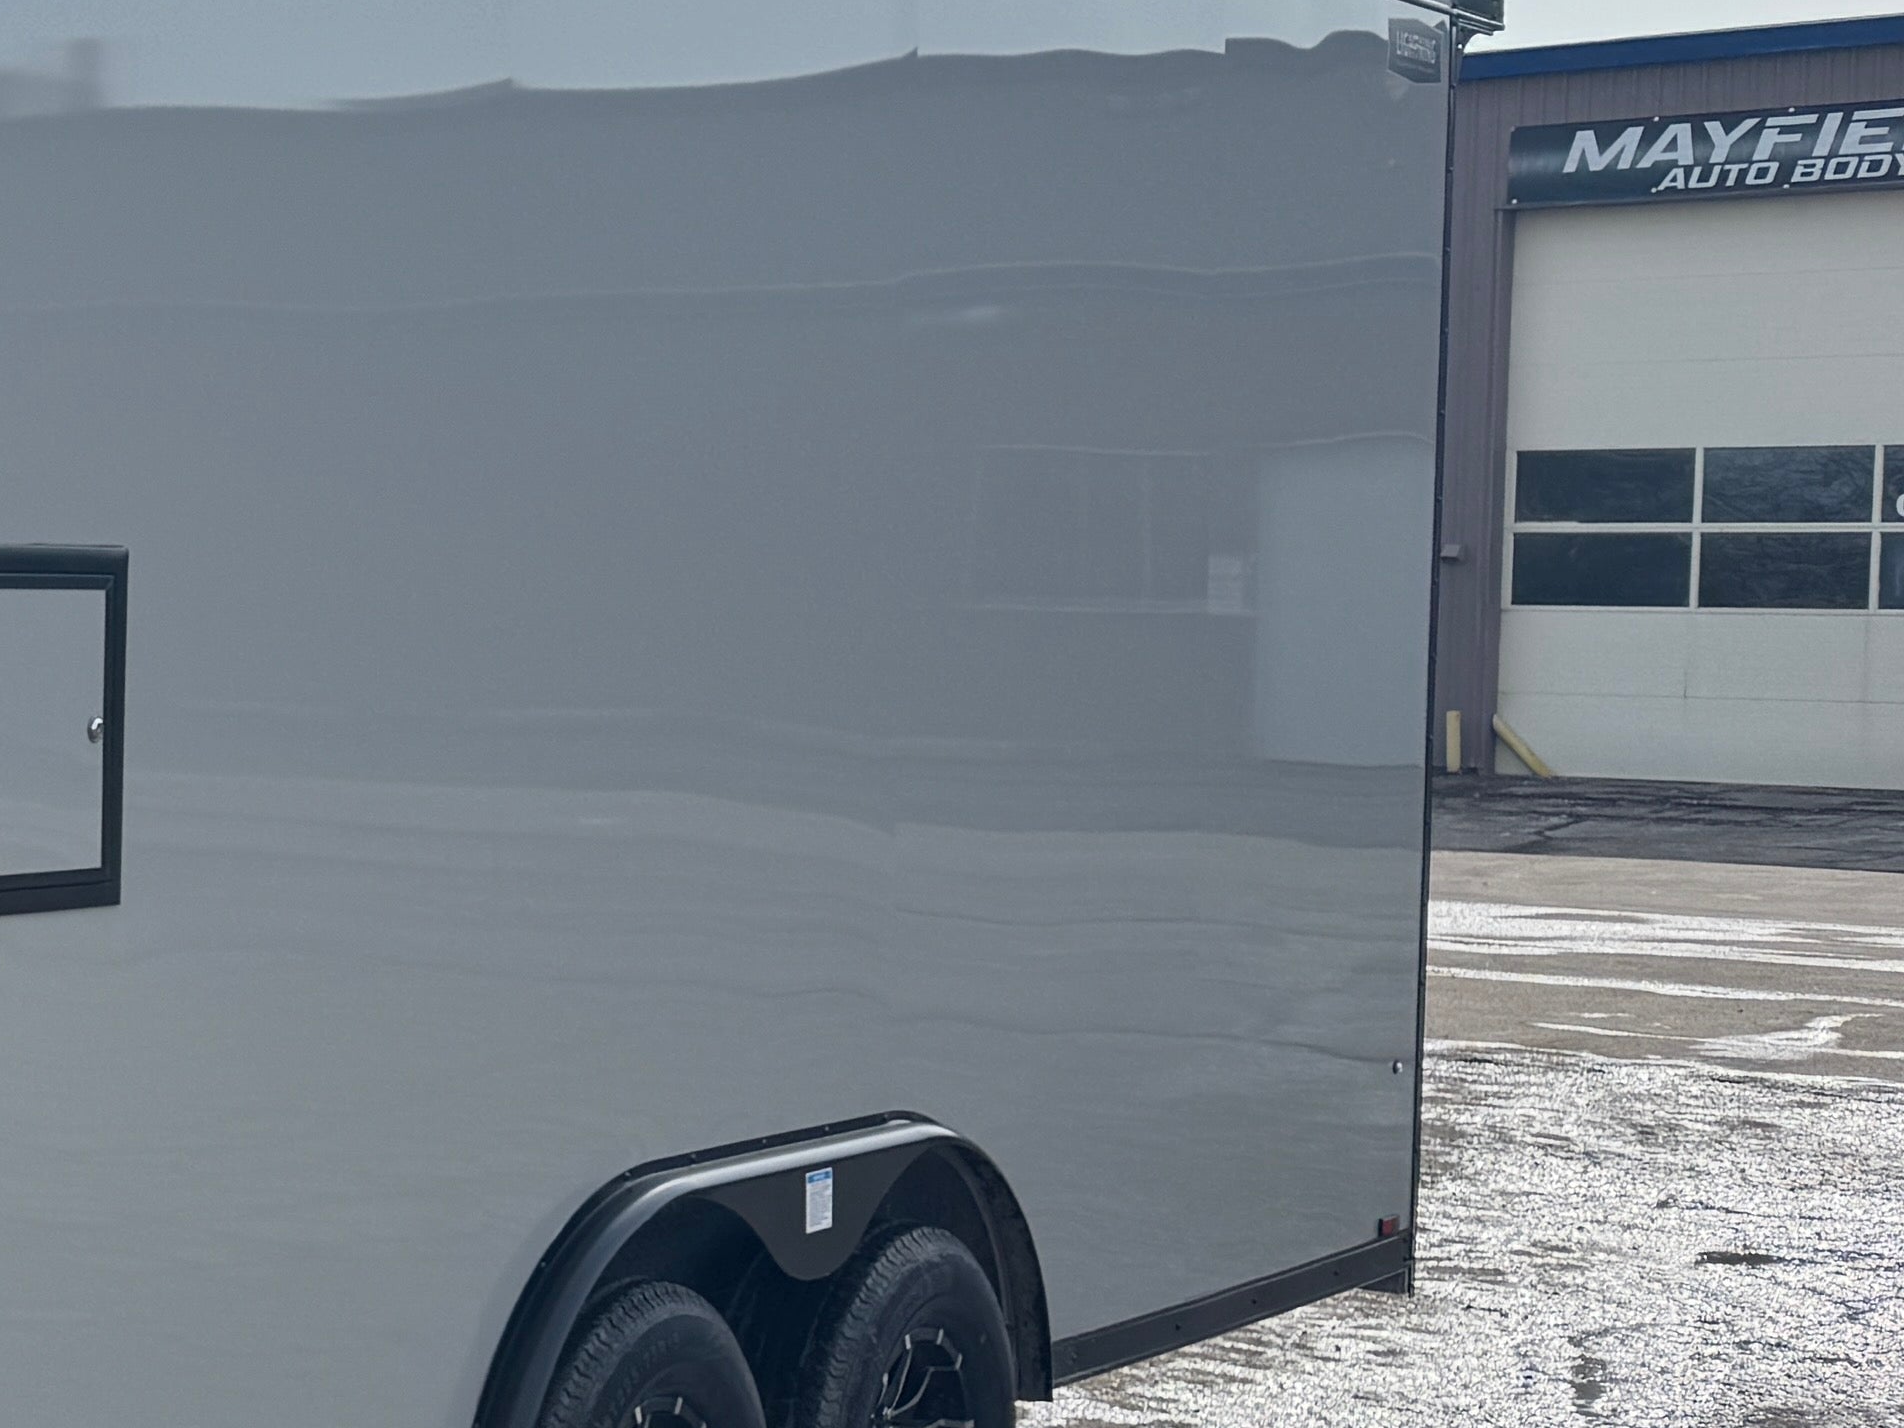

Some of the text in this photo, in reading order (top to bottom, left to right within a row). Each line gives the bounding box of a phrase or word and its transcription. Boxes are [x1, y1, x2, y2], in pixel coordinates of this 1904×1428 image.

[1563, 107, 1904, 173] MAYFIE
[1656, 153, 1904, 191] AUTO BODY
